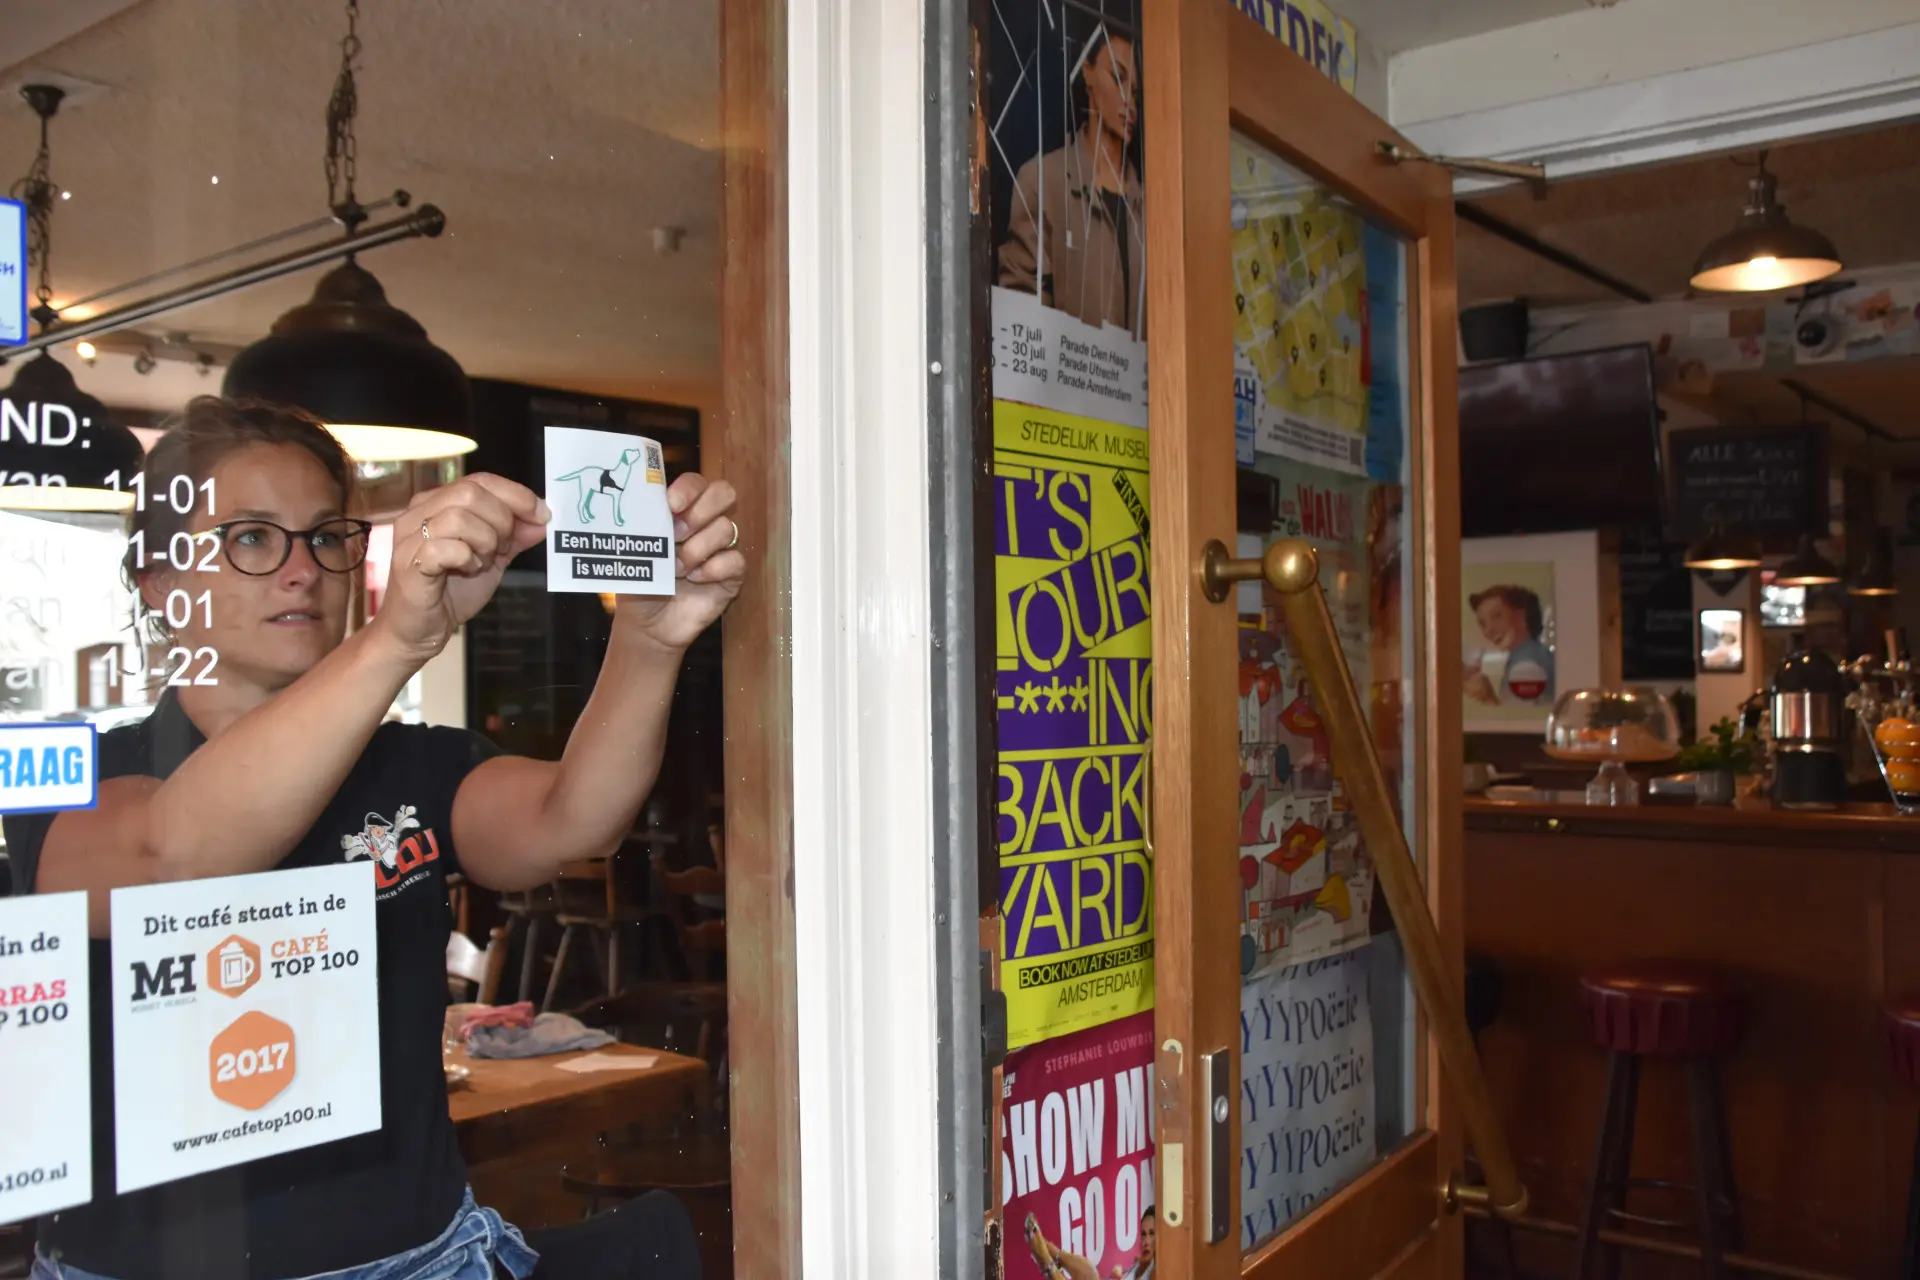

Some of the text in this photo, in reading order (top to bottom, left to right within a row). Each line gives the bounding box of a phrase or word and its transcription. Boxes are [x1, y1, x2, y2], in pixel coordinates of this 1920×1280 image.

[1229, 0, 1344, 84] NTDEK
[1012, 324, 1024, 337] 17
[1026, 326, 1042, 343] juli
[1061, 335, 1089, 356] Parade
[1091, 345, 1108, 361] Den
[1109, 351, 1129, 372] Haag
[1012, 341, 1027, 356] 30
[1030, 345, 1046, 361] juli
[1059, 353, 1087, 374] Parade
[1089, 362, 1120, 381] Utrecht
[1012, 359, 1027, 374] 23
[1030, 366, 1047, 383] aug
[1057, 370, 1086, 391] Parade
[1087, 380, 1132, 402] Amsterdam
[1021, 420, 1098, 452] STEDELIJK
[1113, 469, 1146, 534] FINAL
[561, 533, 663, 555] Een hulphond
[576, 559, 650, 578] is welkom
[1016, 541, 1151, 673] OUR
[998, 755, 1143, 856] BACK
[144, 894, 346, 936] Dit café staat in de
[1000, 852, 1150, 959] YARD
[30, 931, 60, 952] de
[270, 928, 329, 959] CAFÉ
[130, 953, 197, 1003] MH
[271, 949, 359, 979] TOP 100
[1020, 967, 1061, 988] BOOK
[1061, 958, 1089, 983] NOW
[1089, 955, 1104, 973] AT
[1057, 968, 1143, 1008] AMSTERDAM
[17, 1001, 68, 1028] 100
[216, 1042, 289, 1082] 2017
[1045, 1044, 1103, 1074] STEPHANIE
[172, 1102, 332, 1153] www.cafetop100.nl
[0, 1161, 68, 1193] 100.nl
